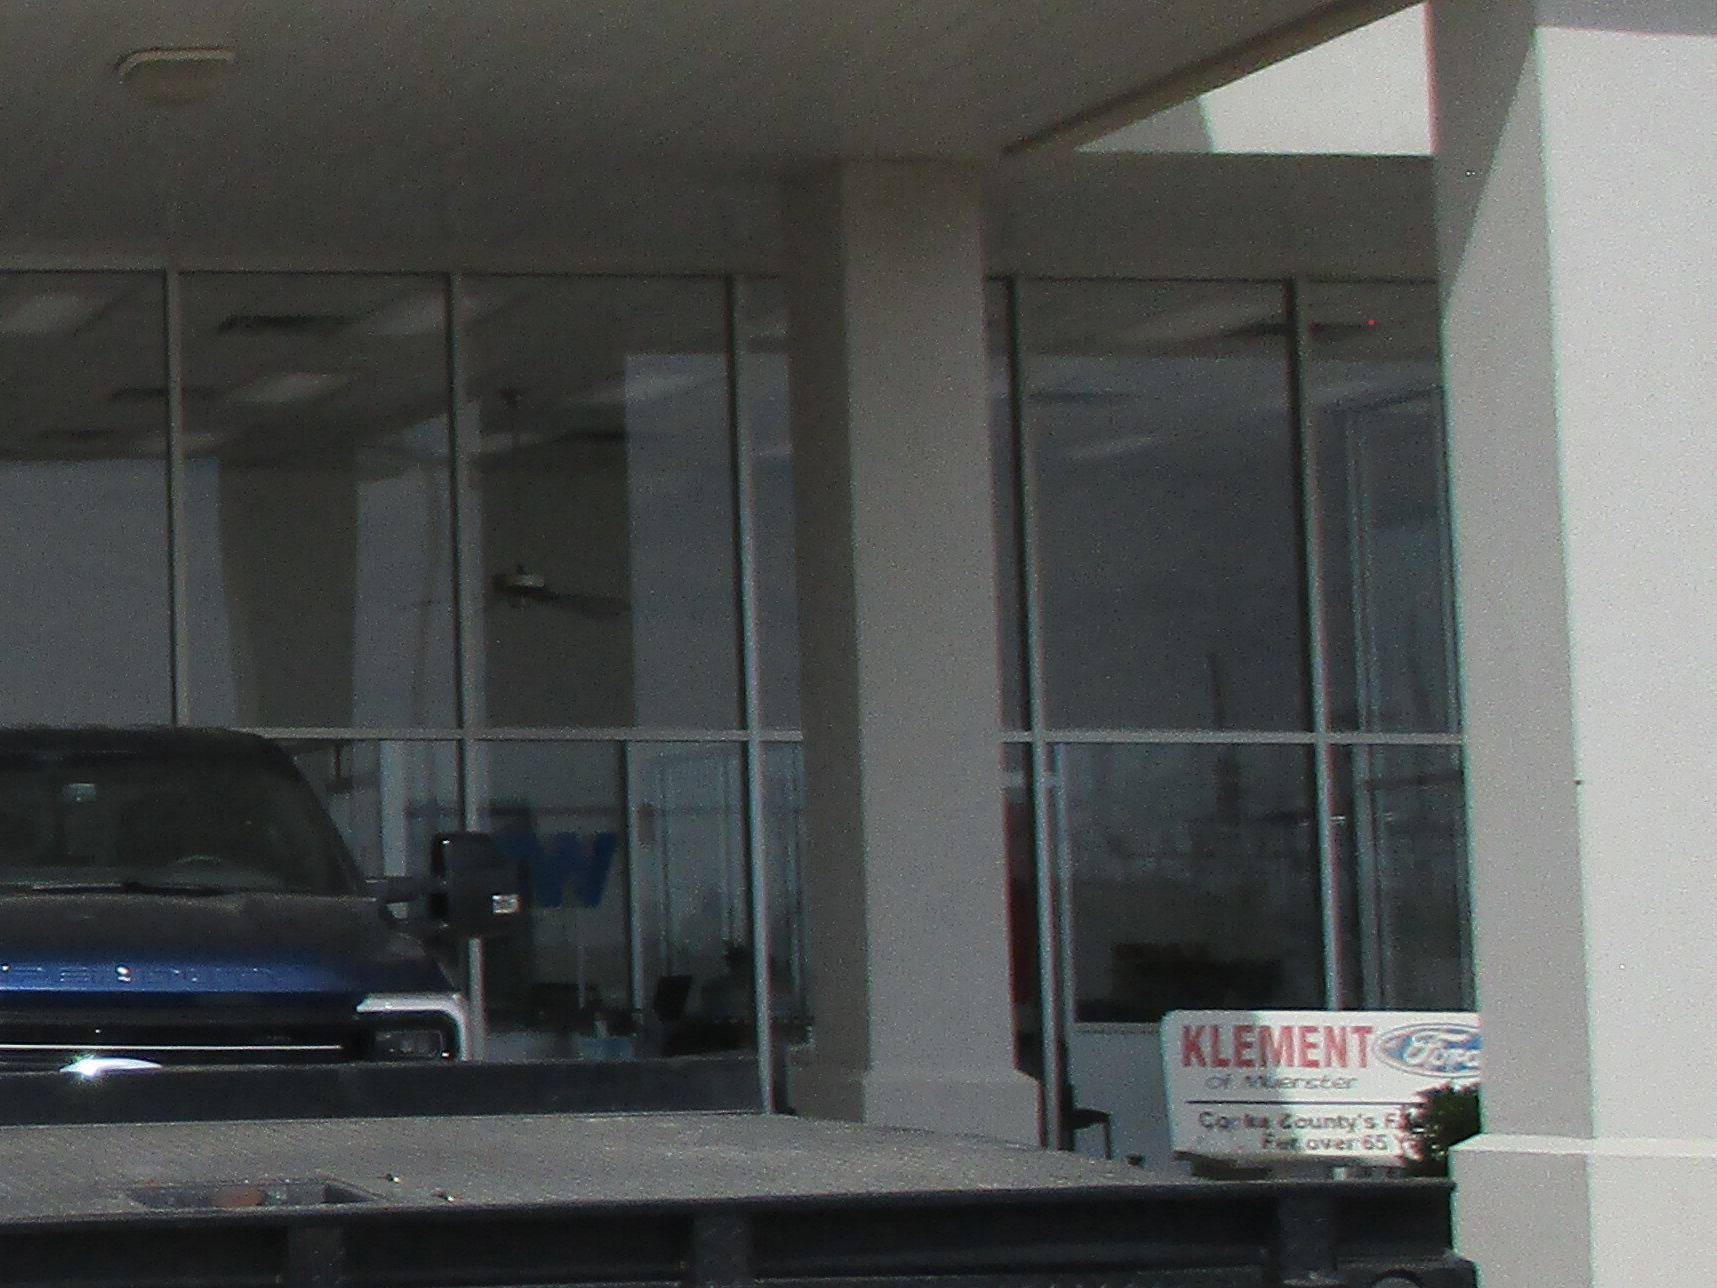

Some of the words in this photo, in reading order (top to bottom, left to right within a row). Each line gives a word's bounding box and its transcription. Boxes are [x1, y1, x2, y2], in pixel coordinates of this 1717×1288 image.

[1180, 1024, 1373, 1069] KLEMENT
[1205, 1073, 1232, 1090] of
[1305, 1137, 1356, 1151] over
